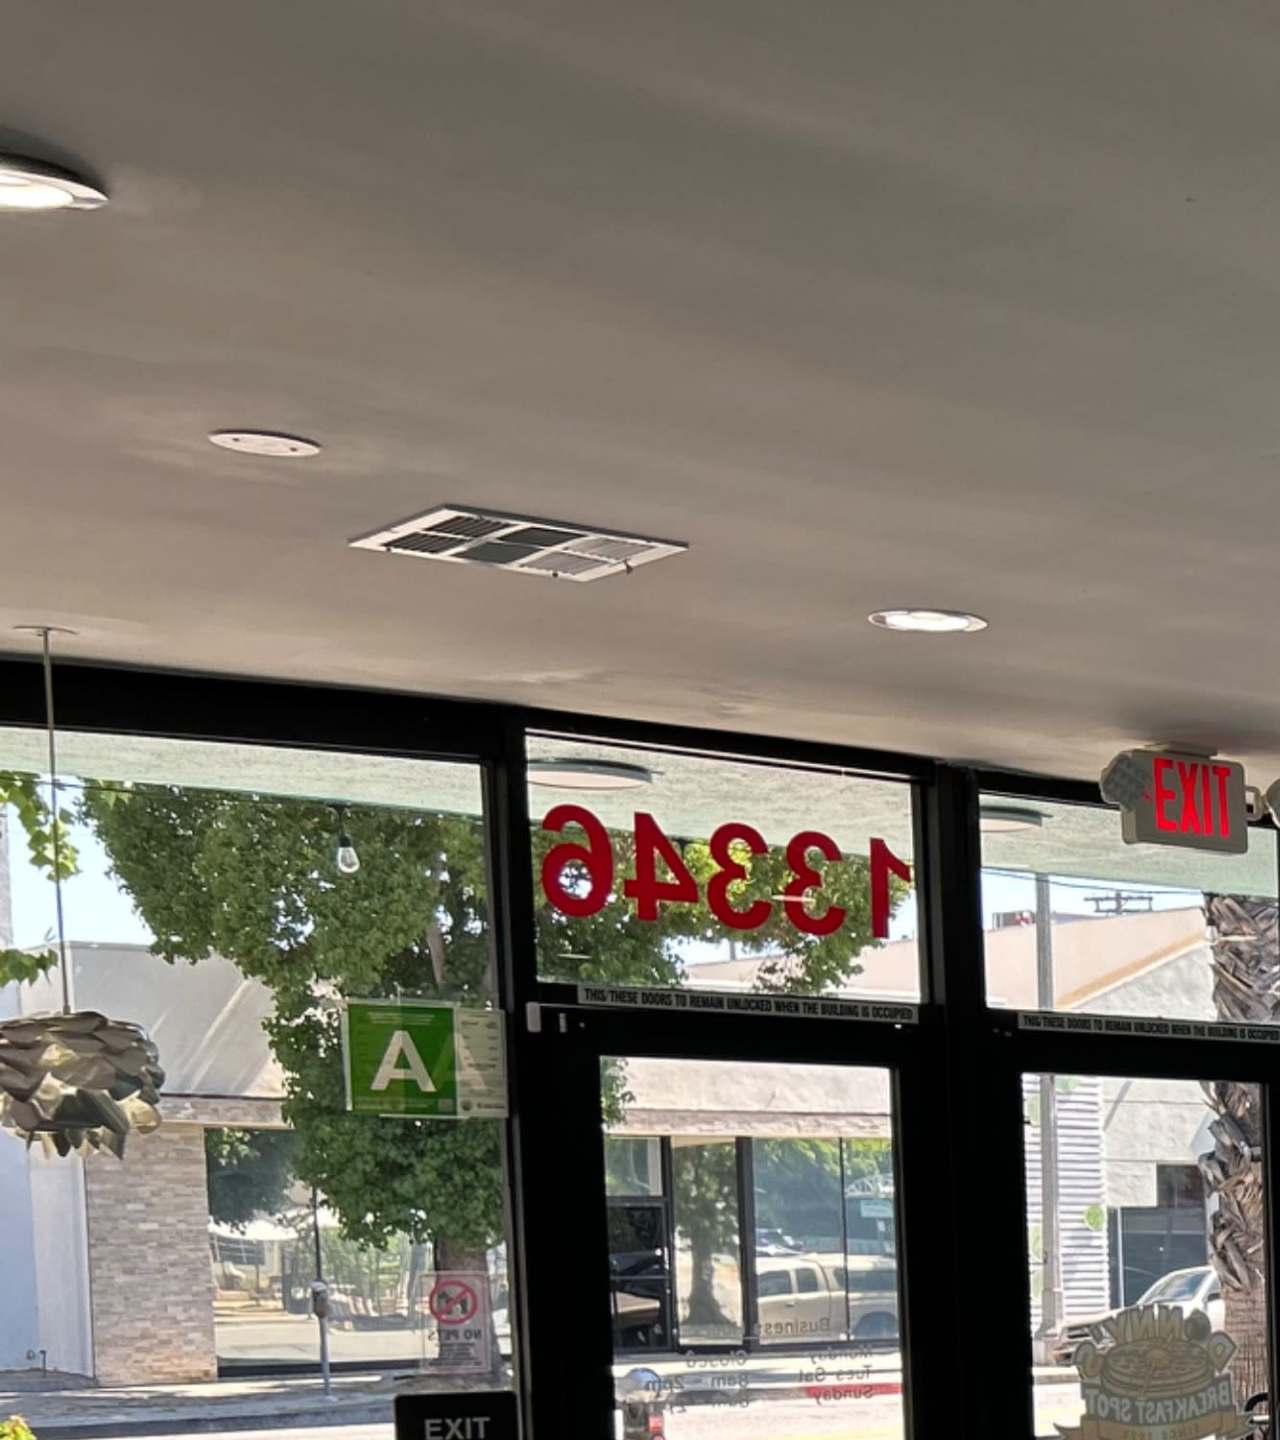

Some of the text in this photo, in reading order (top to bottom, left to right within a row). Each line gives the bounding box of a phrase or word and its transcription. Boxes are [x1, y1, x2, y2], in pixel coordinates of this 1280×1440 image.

[1152, 757, 1232, 839] EXIT
[641, 991, 673, 1006] DOORS
[675, 993, 687, 1008] TO
[689, 995, 725, 1010] REMAIN
[727, 997, 772, 1012] UNLOCKED
[774, 999, 799, 1013] WHEN
[802, 1001, 819, 1015] THE
[821, 1002, 859, 1018] BUILDING
[861, 1005, 870, 1018] IS
[872, 1006, 913, 1020] OCCUPIED
[370, 1030, 438, 1092] A
[424, 1416, 491, 1440] EXIT
